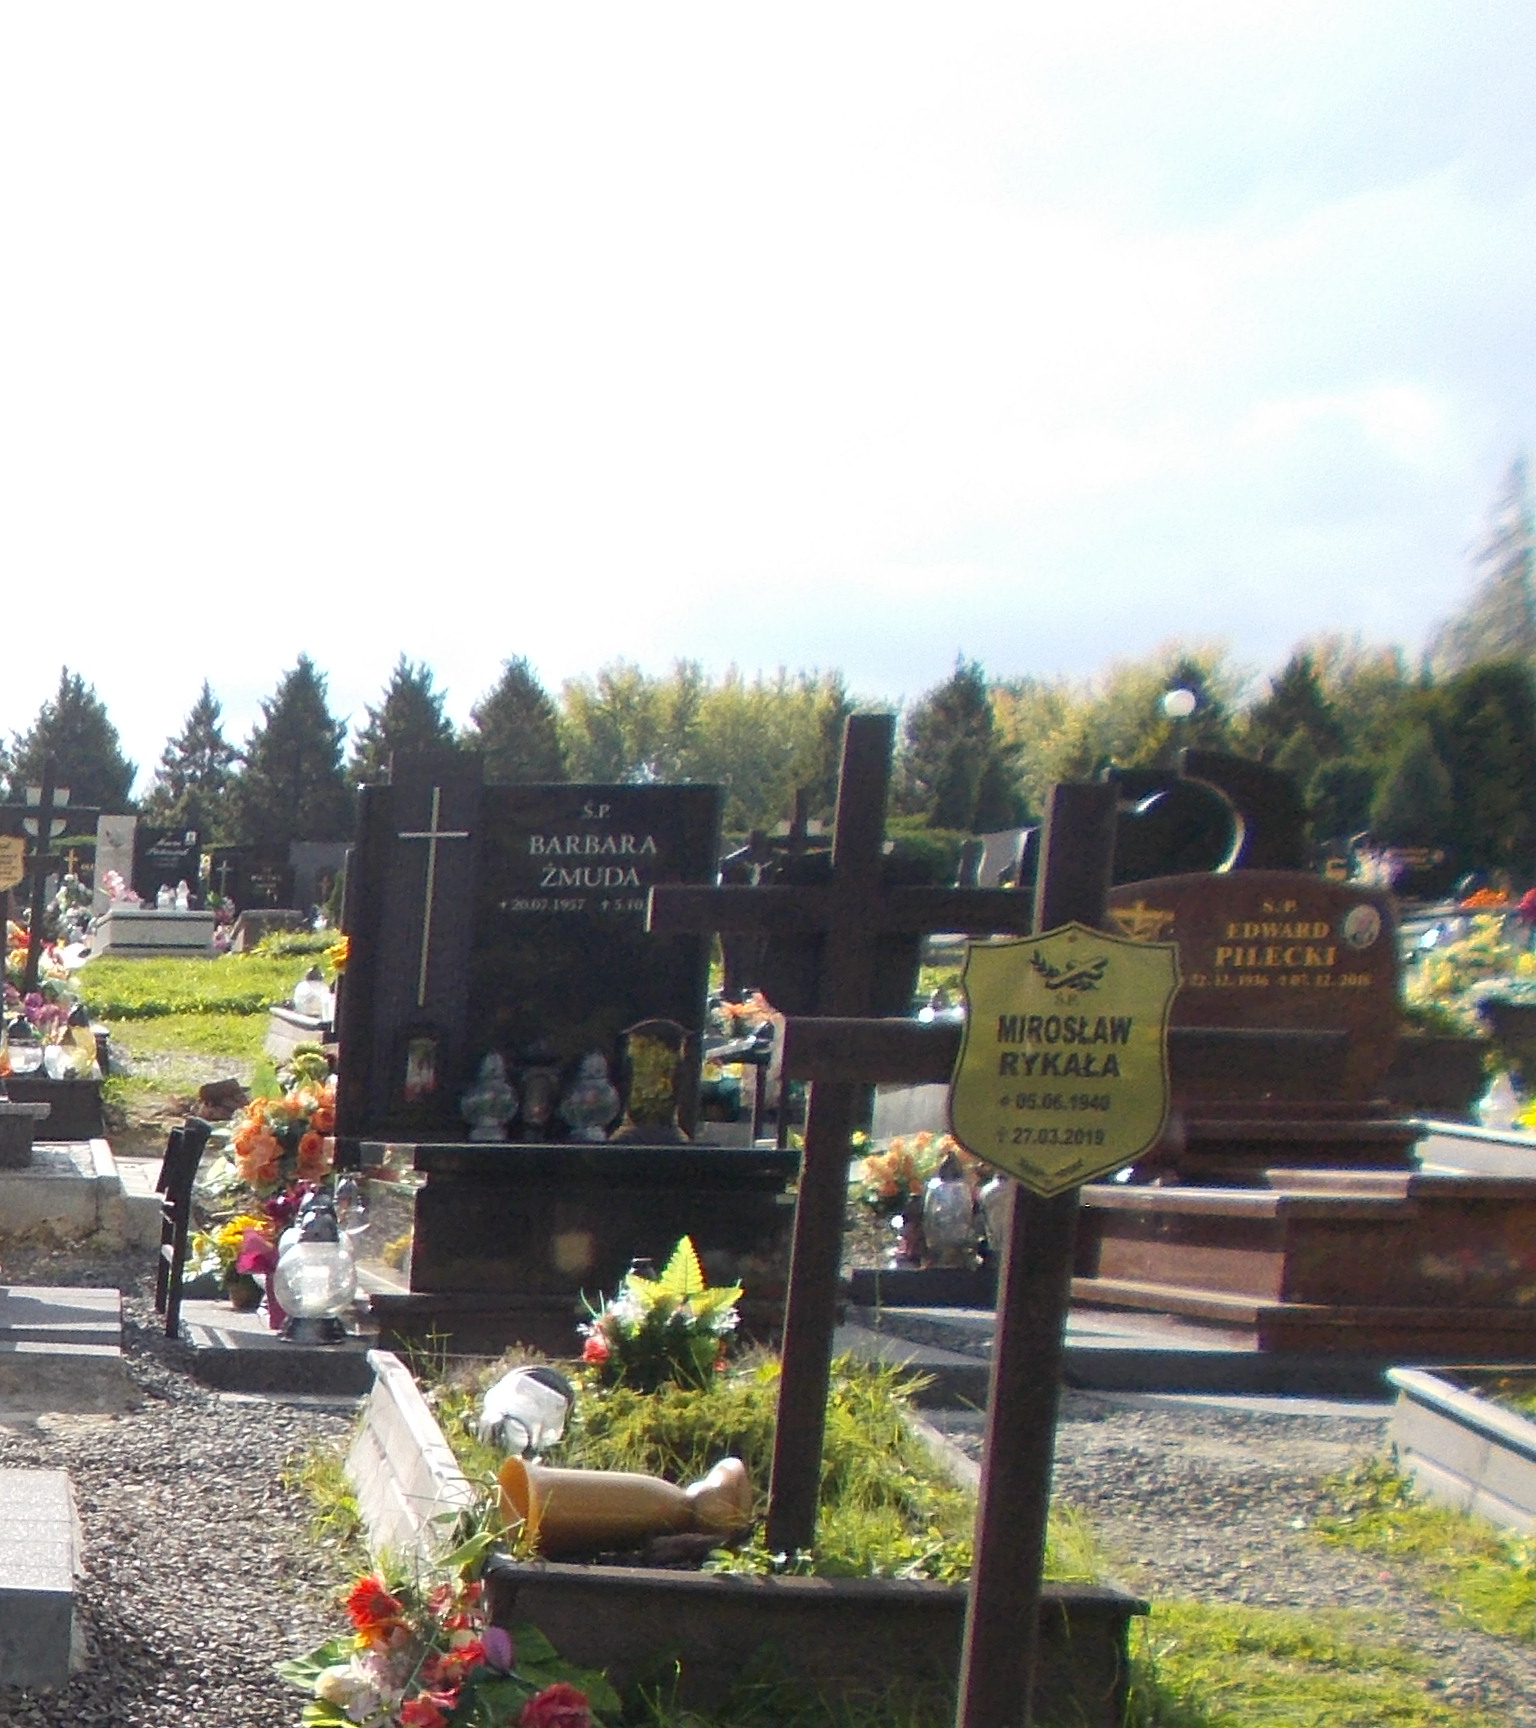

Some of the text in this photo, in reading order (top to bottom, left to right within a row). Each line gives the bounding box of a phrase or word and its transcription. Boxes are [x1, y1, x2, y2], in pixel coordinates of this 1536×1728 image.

[529, 835, 657, 855] BARBARA
[540, 862, 640, 887] ŻMUDA
[1227, 922, 1330, 939] EDWARD
[1215, 946, 1338, 967] PILECKI
[997, 1014, 1133, 1045] MIROSŁAW
[999, 1052, 1121, 1078] RYKAŁA
